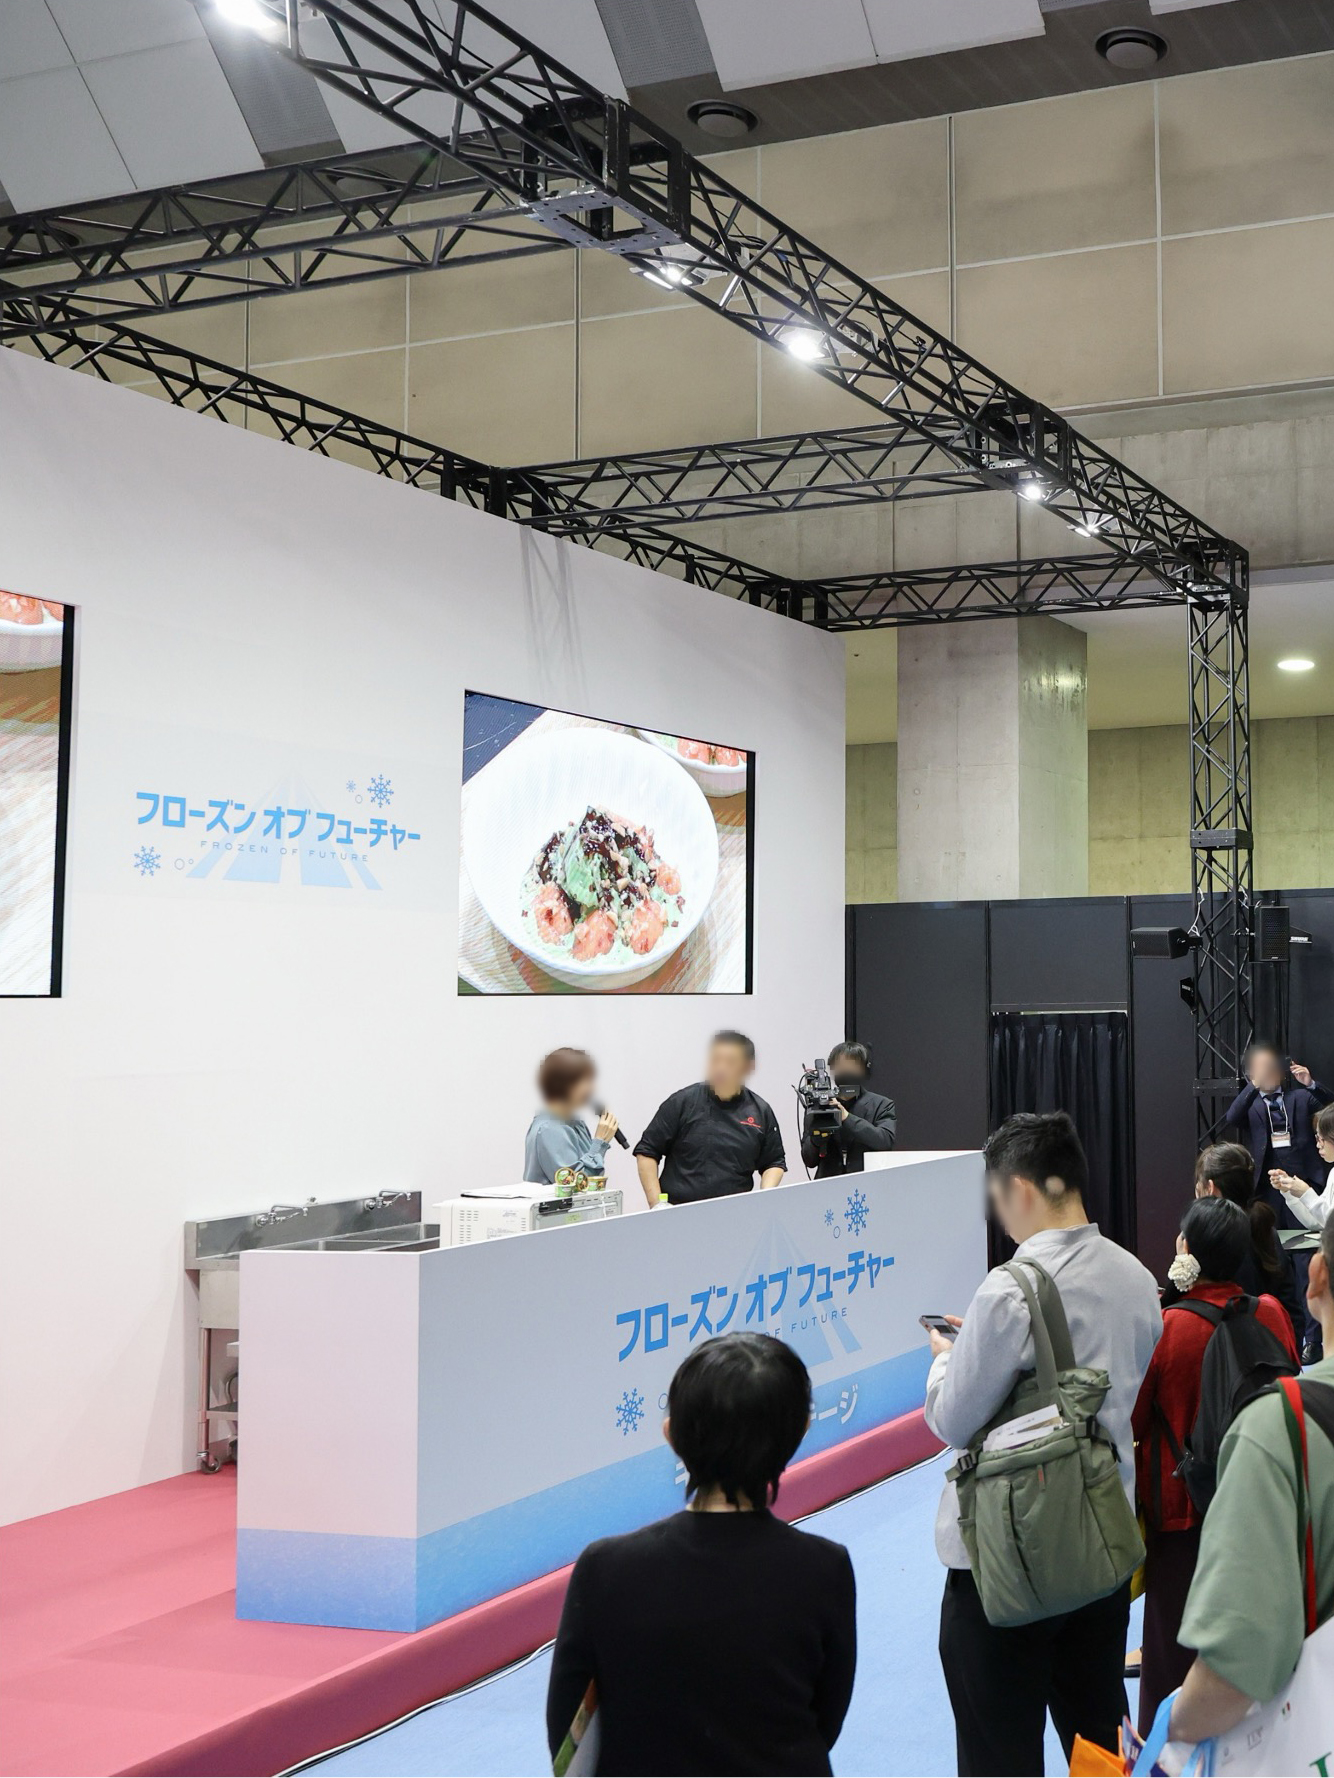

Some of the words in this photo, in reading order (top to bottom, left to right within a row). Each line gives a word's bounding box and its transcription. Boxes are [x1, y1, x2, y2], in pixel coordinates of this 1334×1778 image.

[136, 791, 257, 834] フローズン
[263, 805, 311, 839] オブ
[316, 812, 421, 851] フューチャー
[200, 840, 268, 854] FROZEN
[279, 848, 298, 856] OF
[309, 850, 369, 862] FUTURE
[616, 1285, 738, 1362] フローズン
[745, 1267, 792, 1324] オブ
[796, 1250, 895, 1308] フューチャー
[791, 1307, 848, 1333] FUTURE
[809, 1383, 858, 1424] ージ
